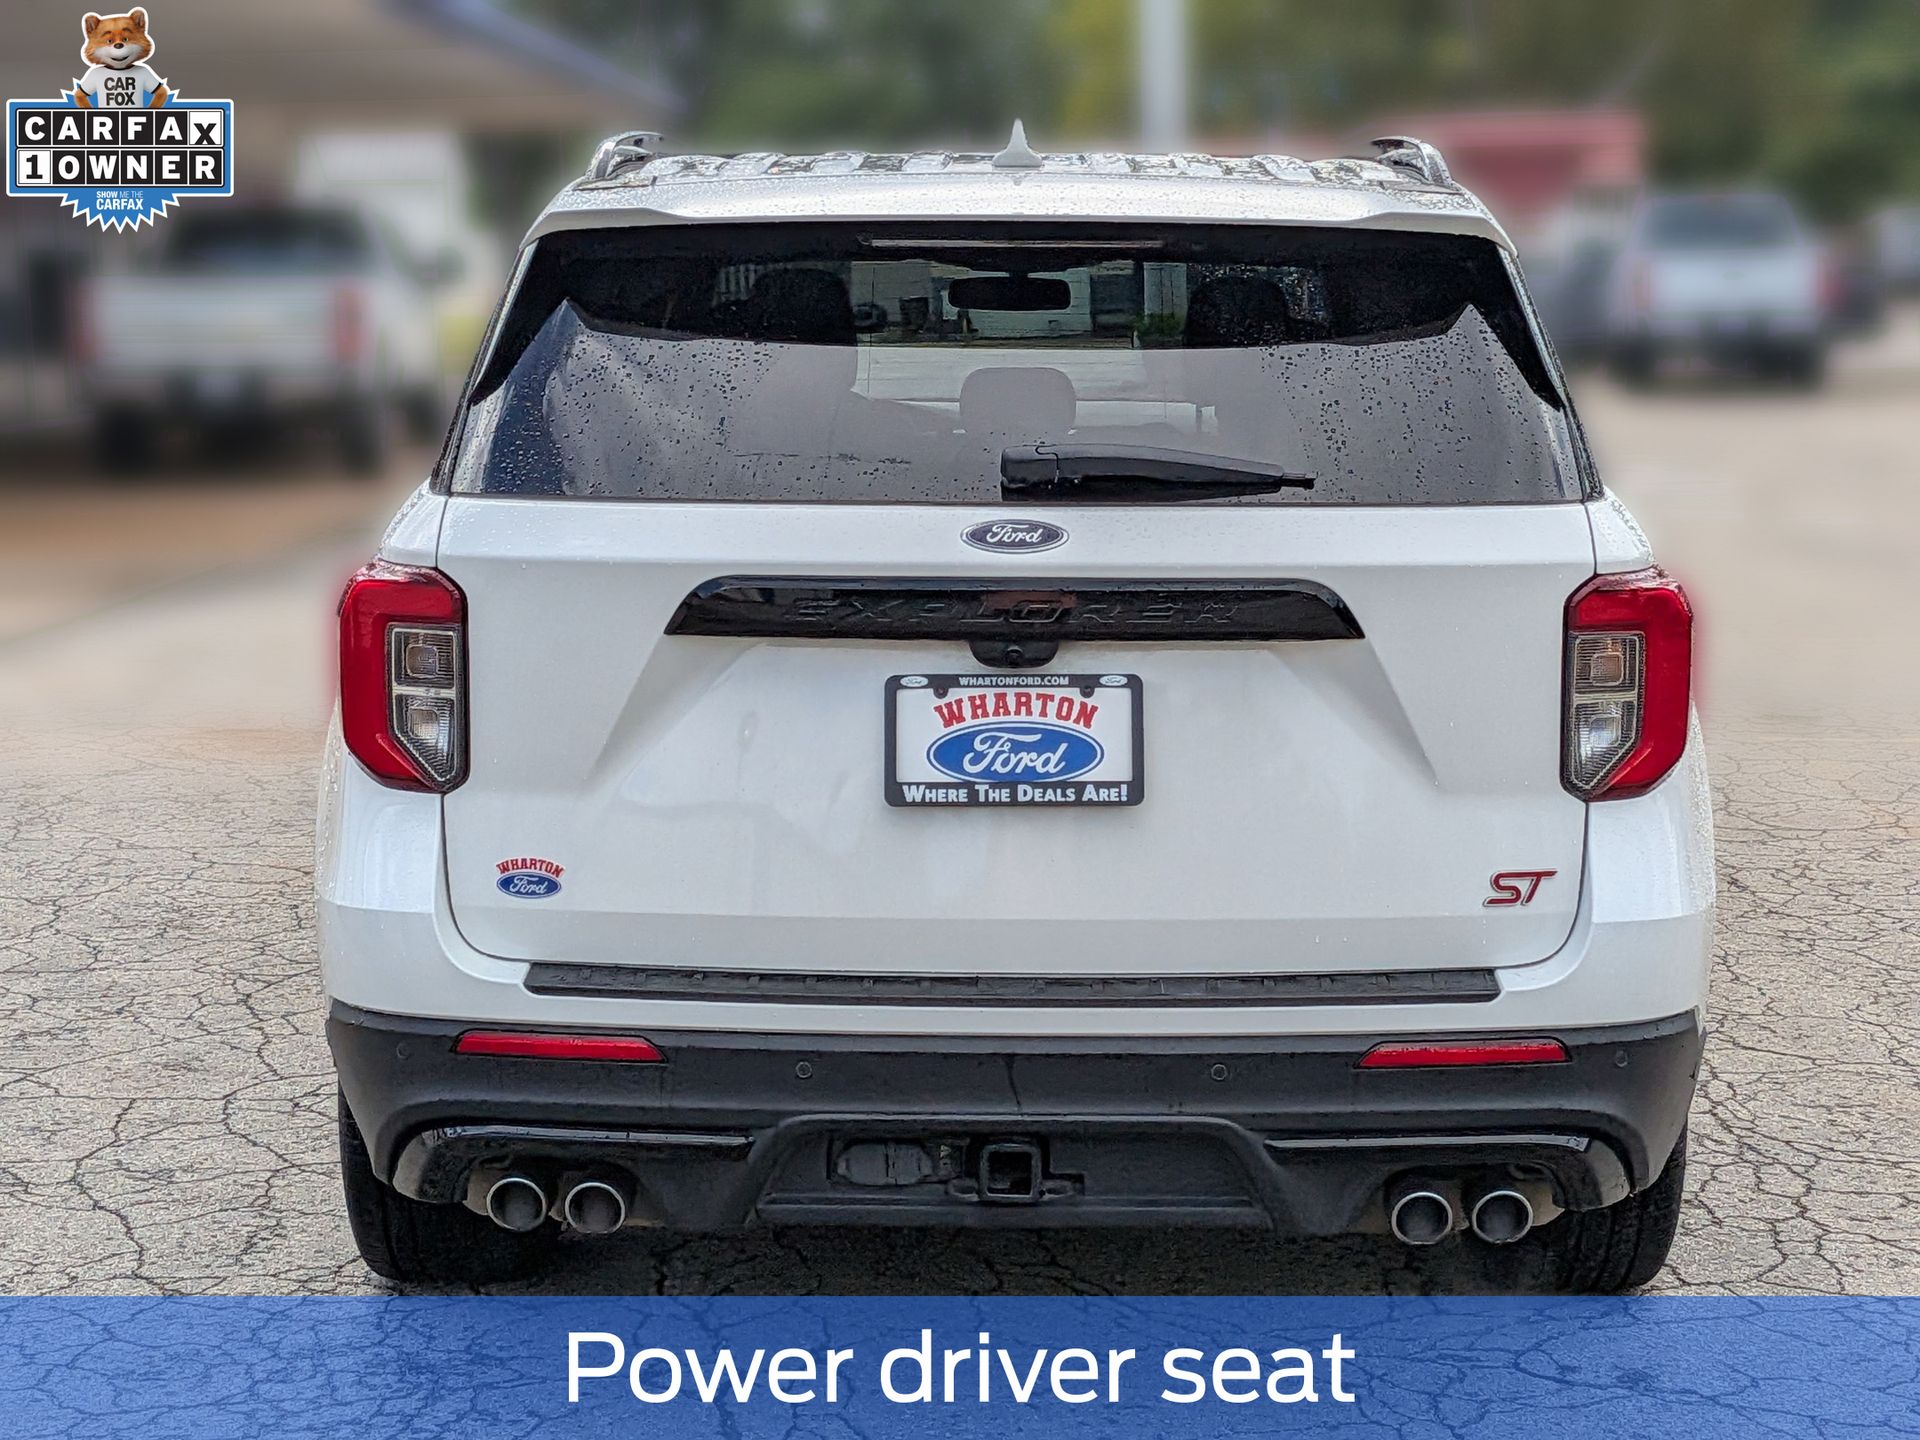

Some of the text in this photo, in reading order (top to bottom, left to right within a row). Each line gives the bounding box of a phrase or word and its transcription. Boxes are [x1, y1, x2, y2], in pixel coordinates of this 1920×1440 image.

[986, 524, 1043, 543] Ford
[791, 597, 1240, 624] EXPLORER
[959, 676, 1069, 686] WHARTONFORD.COM
[933, 692, 1098, 729] WHARTON
[963, 731, 1069, 774] Ford
[496, 858, 564, 878] WHARTON
[509, 875, 549, 894] Ford
[1482, 867, 1558, 907] ST
